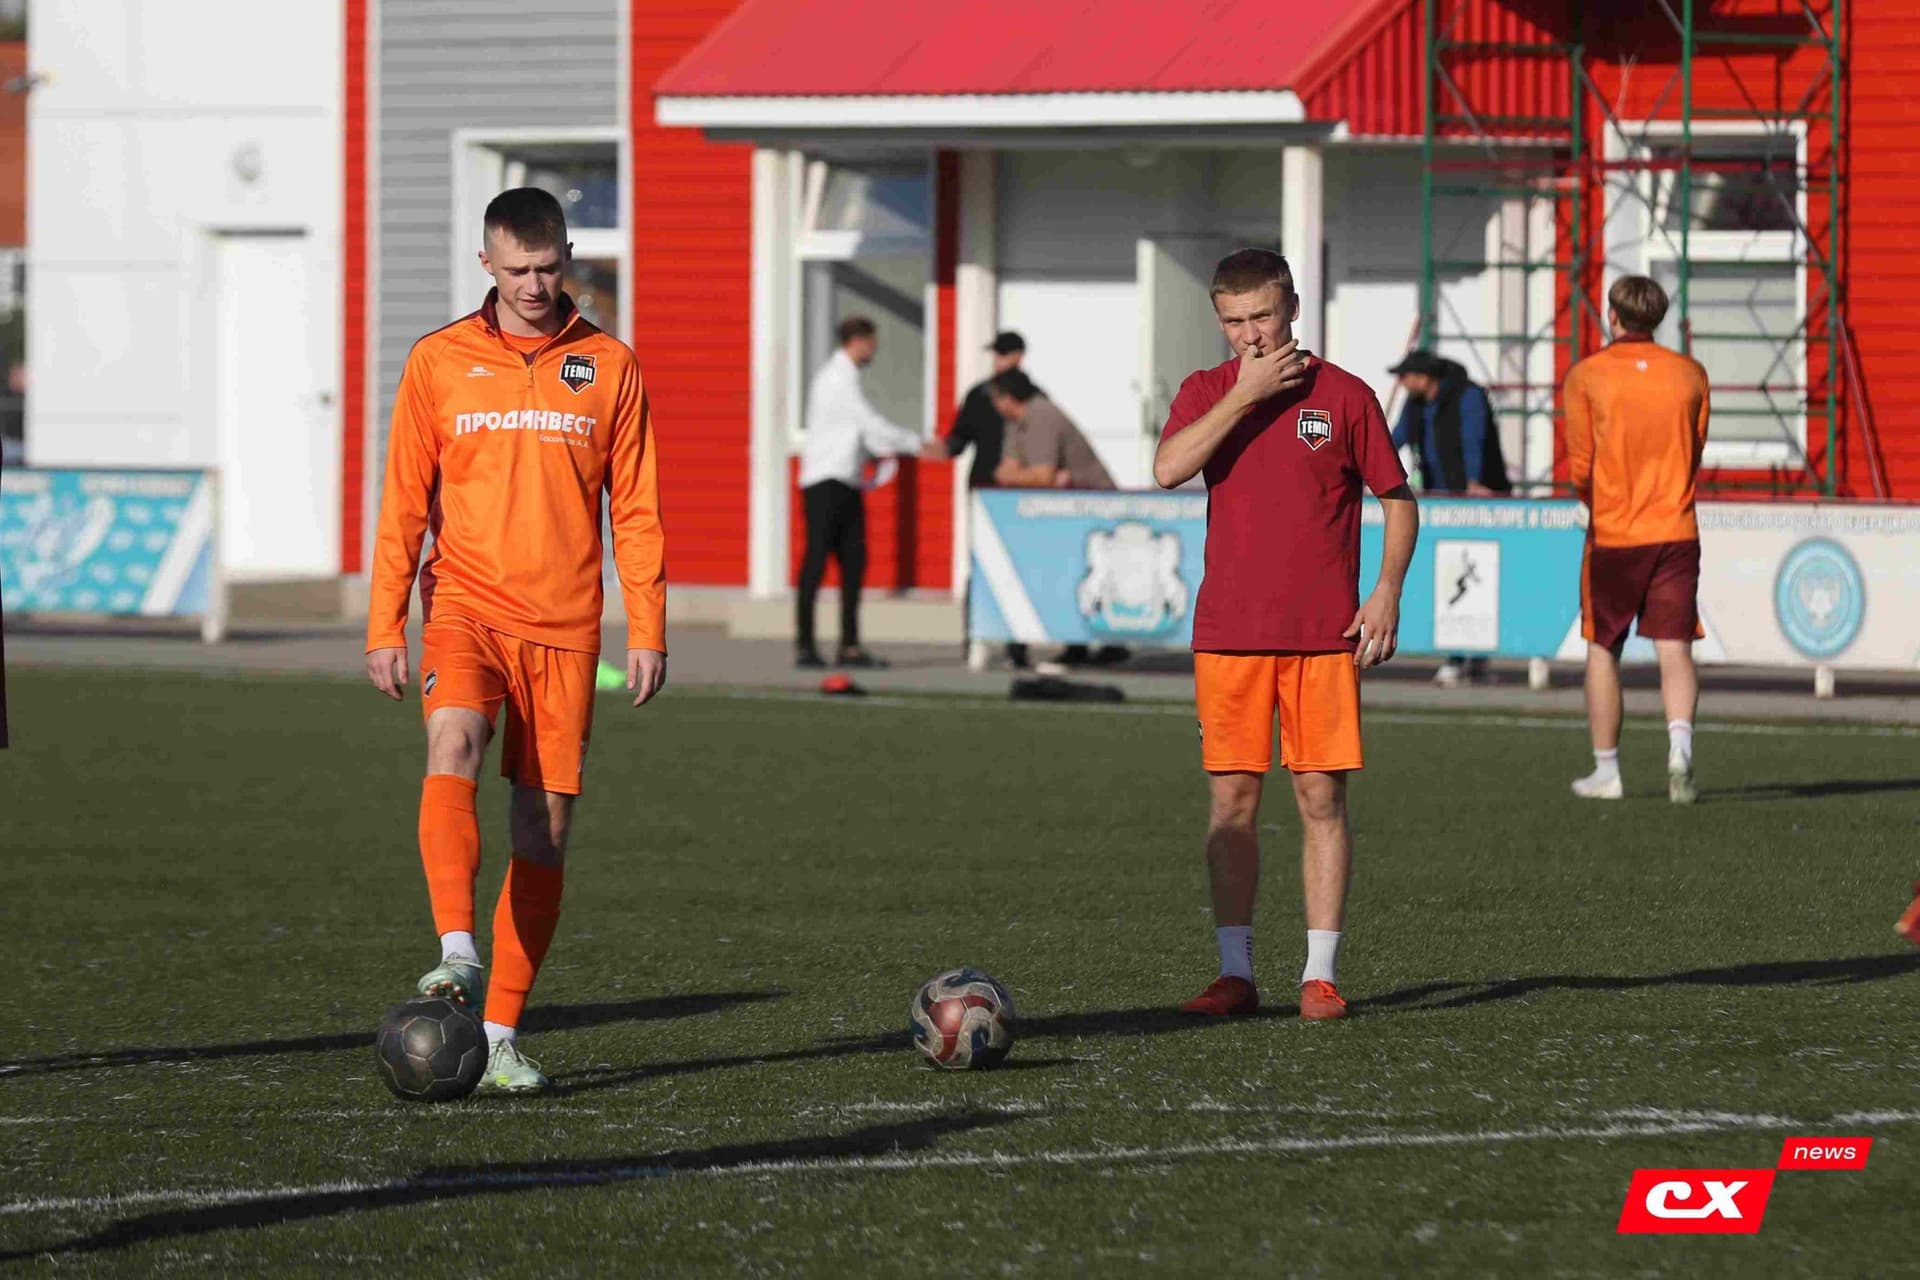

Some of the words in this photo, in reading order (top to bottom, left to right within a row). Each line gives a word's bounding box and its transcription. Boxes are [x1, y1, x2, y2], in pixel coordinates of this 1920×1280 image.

[564, 364, 593, 381] ТЕМП
[455, 409, 597, 437] ПРОДИНВЕСТ
[1300, 420, 1329, 437] ТЕМП
